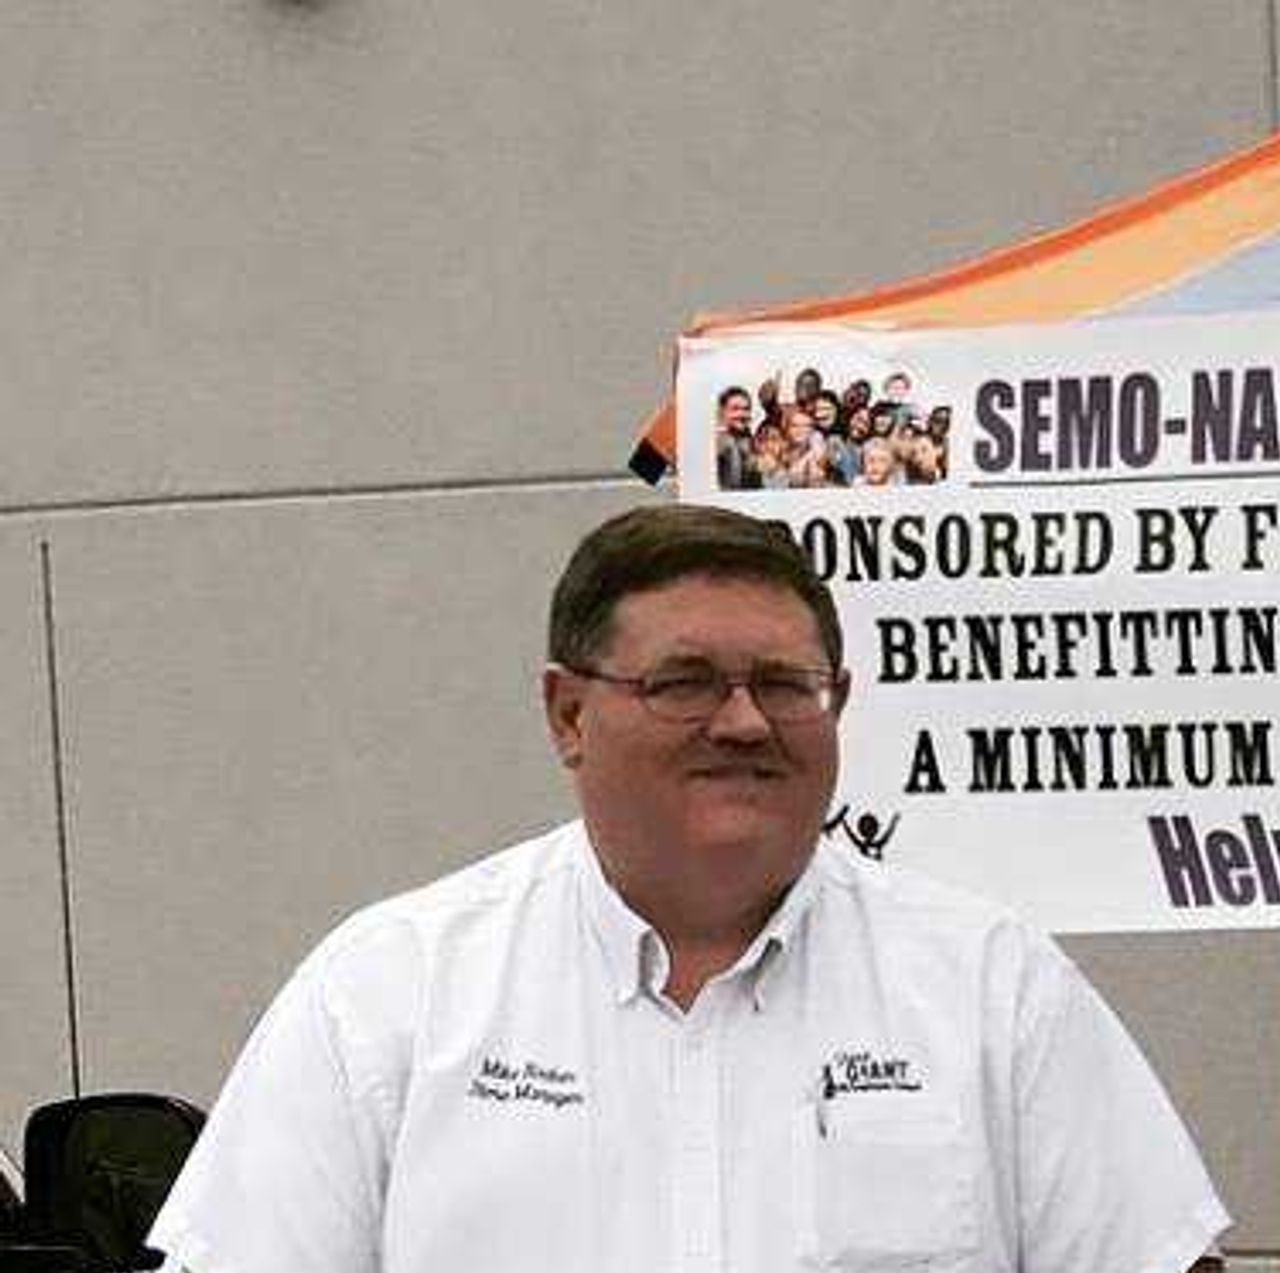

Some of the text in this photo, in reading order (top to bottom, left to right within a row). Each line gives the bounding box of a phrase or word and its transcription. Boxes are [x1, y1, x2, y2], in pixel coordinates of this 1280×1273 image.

[1134, 505, 1219, 574] BY
[904, 729, 947, 794] A
[966, 720, 1275, 793] MINIMUM
